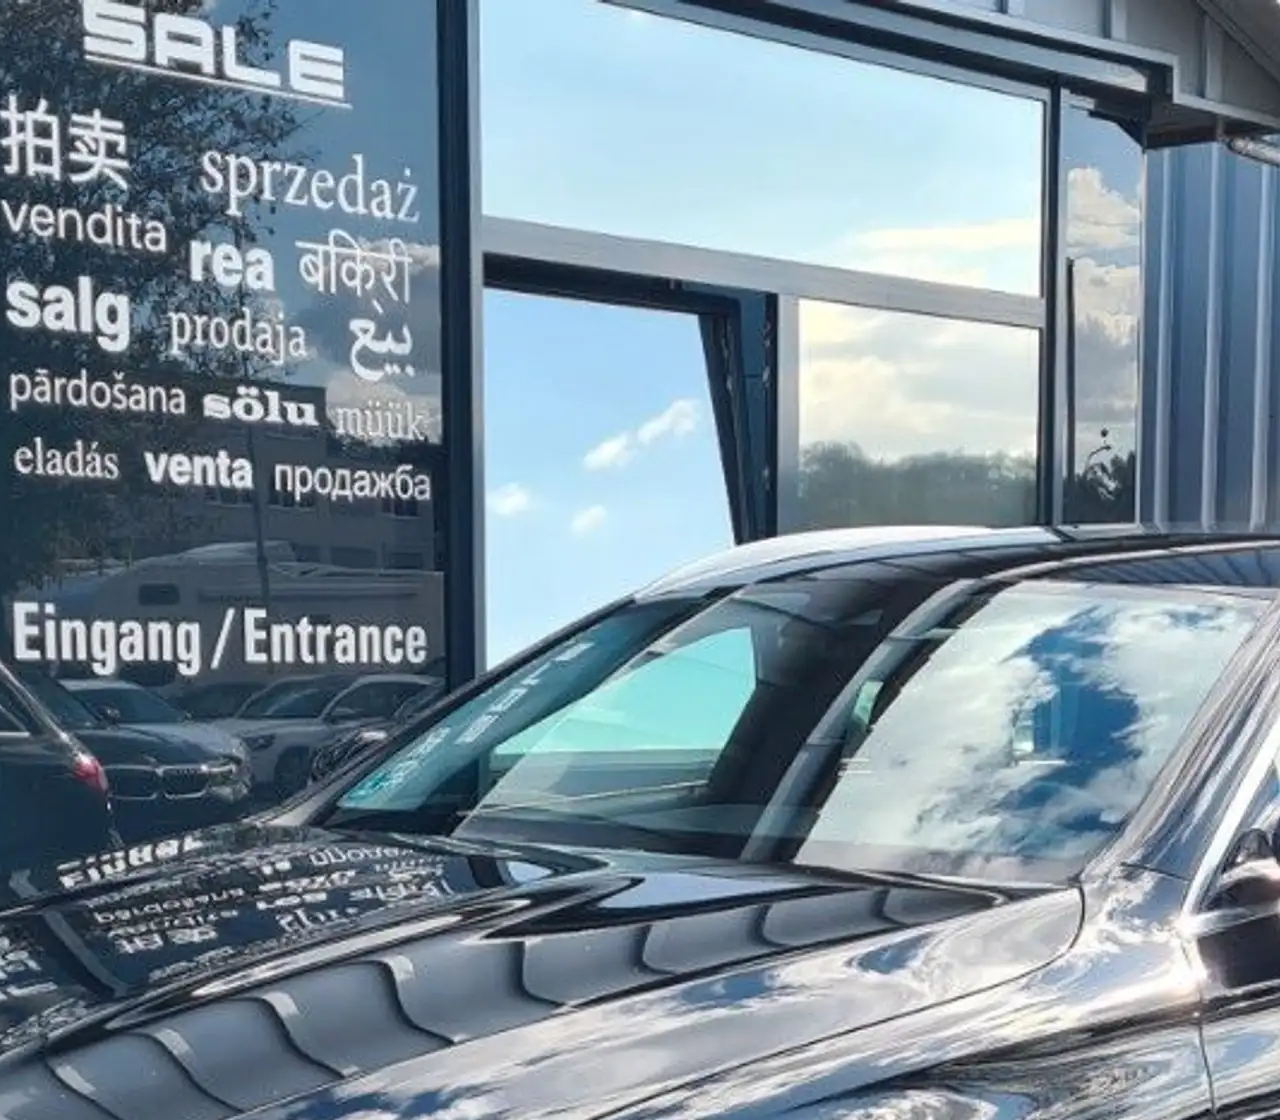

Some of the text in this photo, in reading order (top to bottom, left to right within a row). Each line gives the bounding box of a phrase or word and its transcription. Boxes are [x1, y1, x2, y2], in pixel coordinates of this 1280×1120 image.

[83, 0, 346, 99] SALE
[0, 95, 130, 190] 拍卖
[201, 150, 419, 222] sprzedaż
[1, 200, 167, 252] vendita
[190, 239, 275, 291] rea
[6, 276, 131, 352] salg
[168, 308, 308, 365] prodaja
[10, 369, 425, 440] pārdošana sölu müük
[14, 437, 253, 488] eladás venta
[274, 464, 431, 501] продажба
[13, 602, 427, 676] Eingang / Entrance
